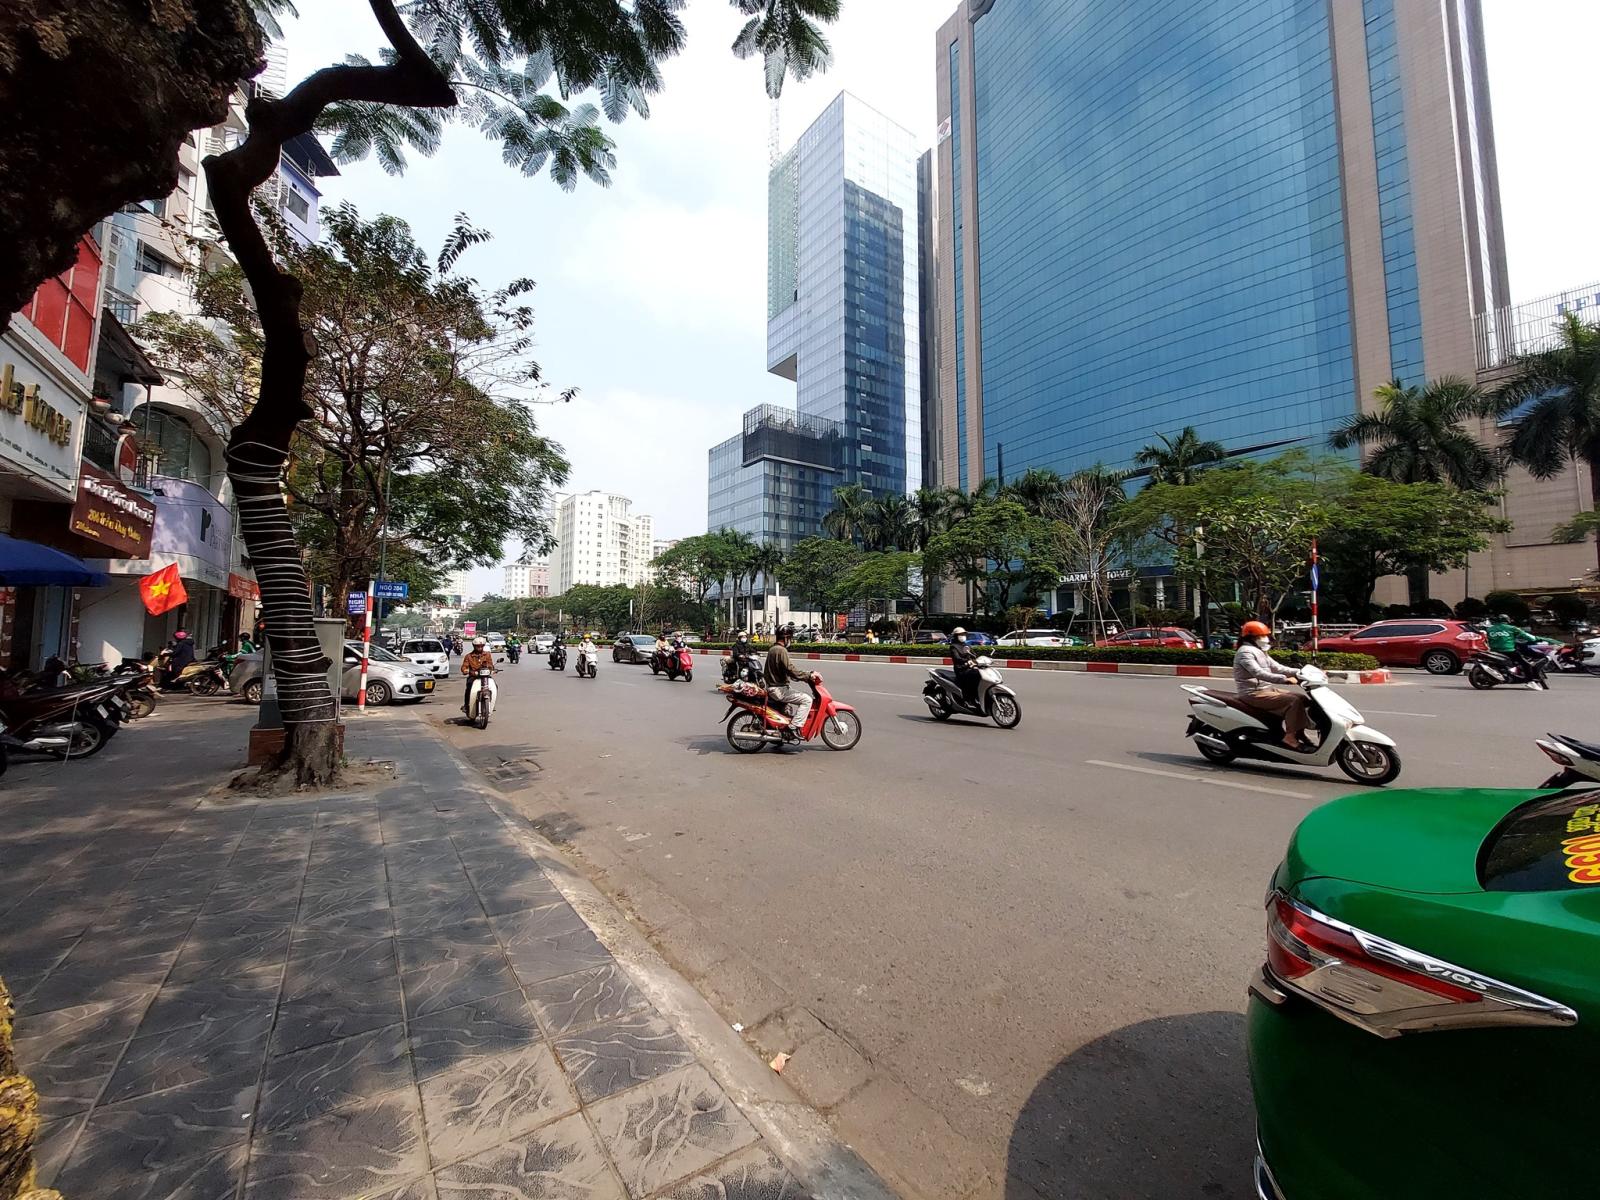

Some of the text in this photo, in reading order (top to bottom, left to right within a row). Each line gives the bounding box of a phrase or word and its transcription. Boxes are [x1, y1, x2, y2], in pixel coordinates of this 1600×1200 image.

[1059, 573, 1088, 583] CHARM
[1106, 569, 1132, 580] TOWE
[1423, 962, 1487, 990] VIOS
